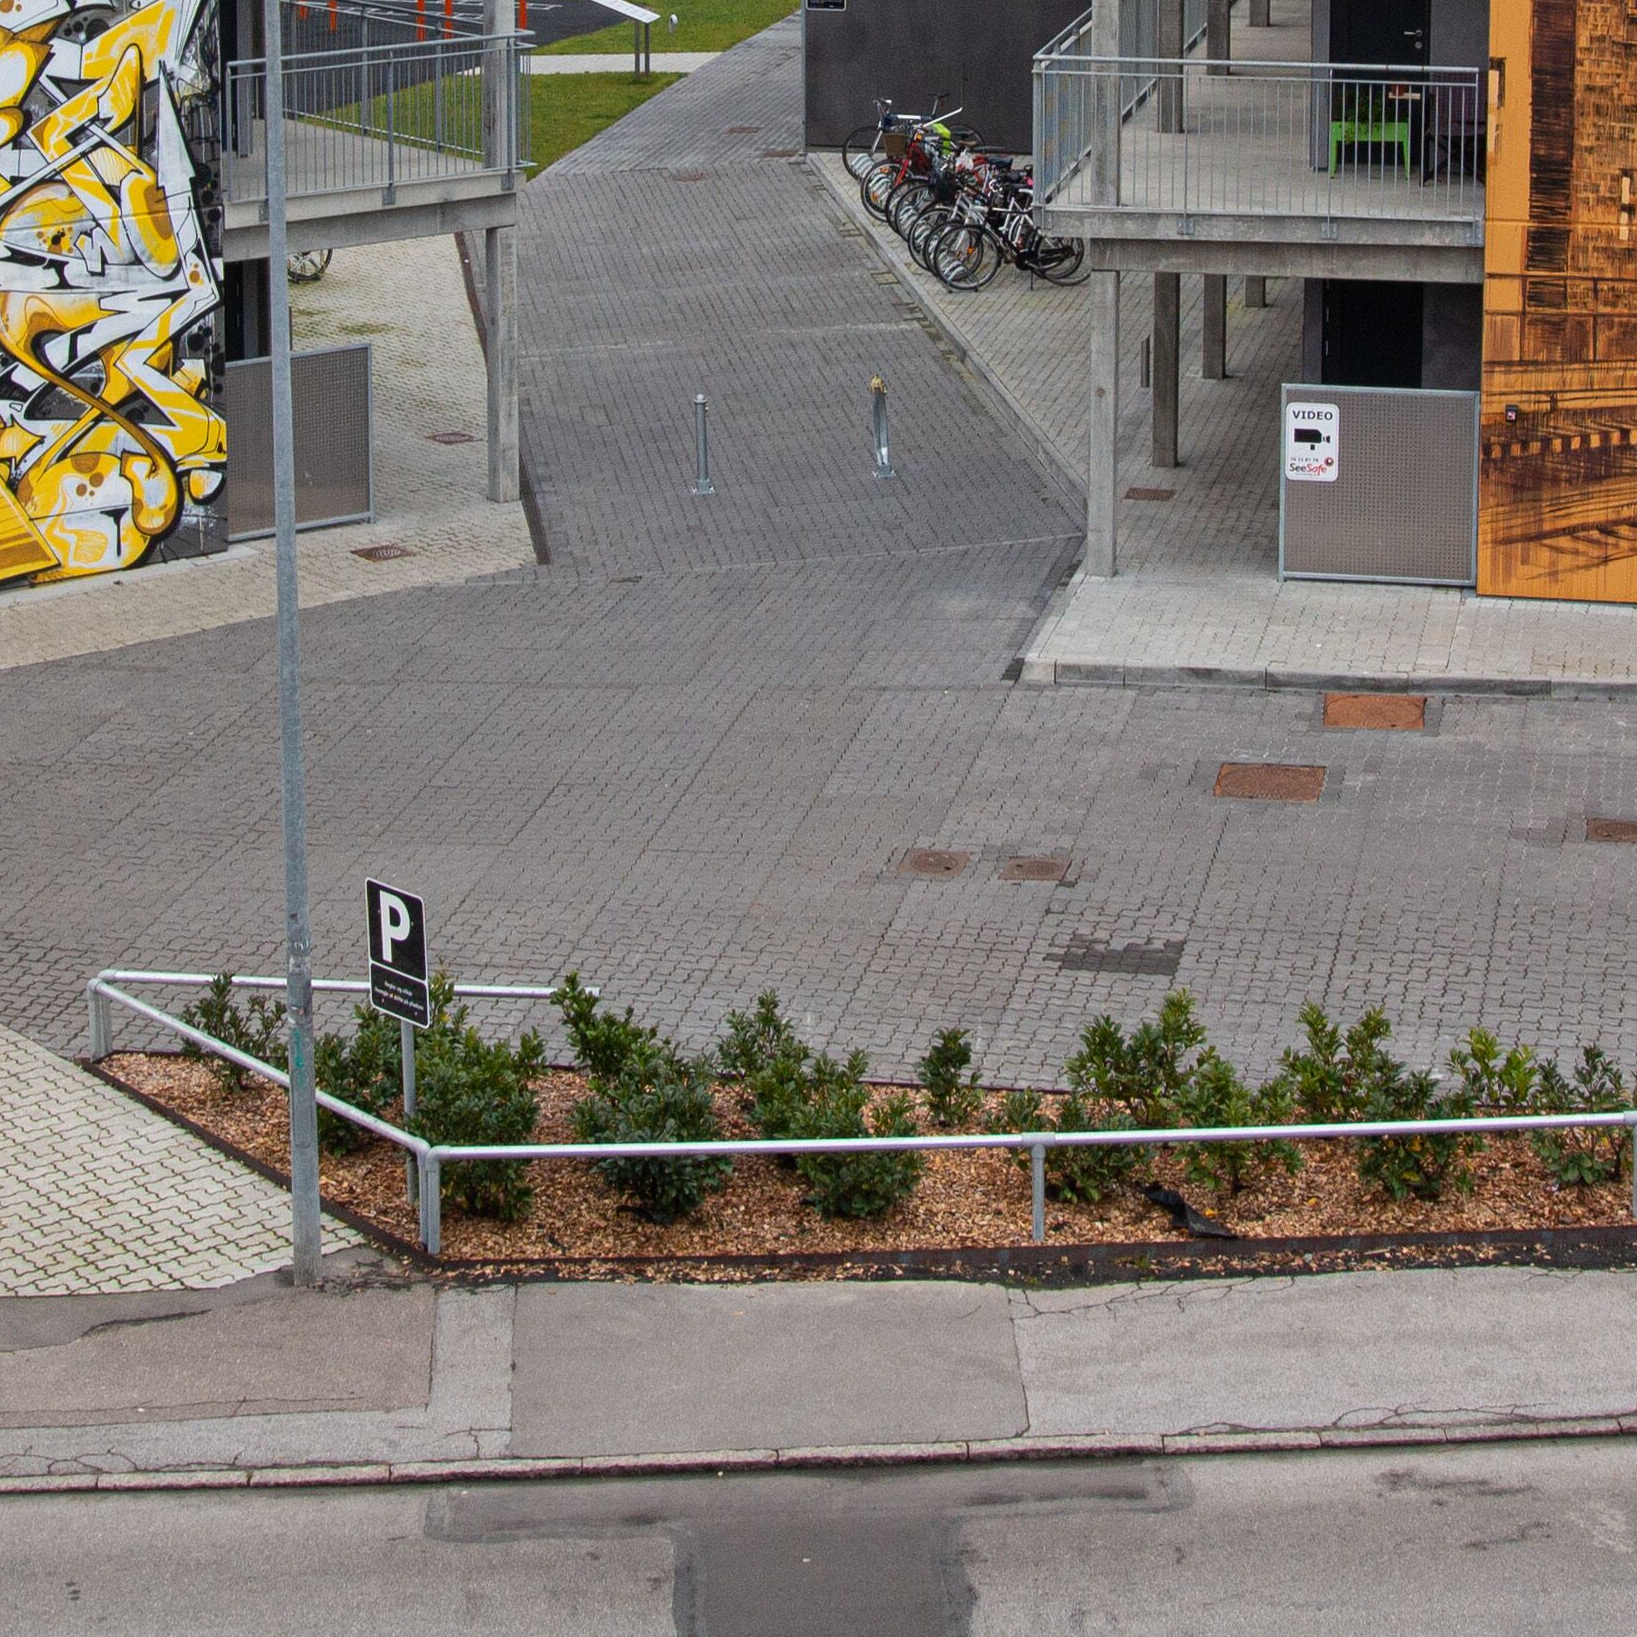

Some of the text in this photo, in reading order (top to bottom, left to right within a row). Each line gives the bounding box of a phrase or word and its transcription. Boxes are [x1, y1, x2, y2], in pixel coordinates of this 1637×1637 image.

[1292, 410, 1333, 421] VIDEO
[1289, 462, 1327, 476] SeeSafe
[379, 889, 411, 963] P
